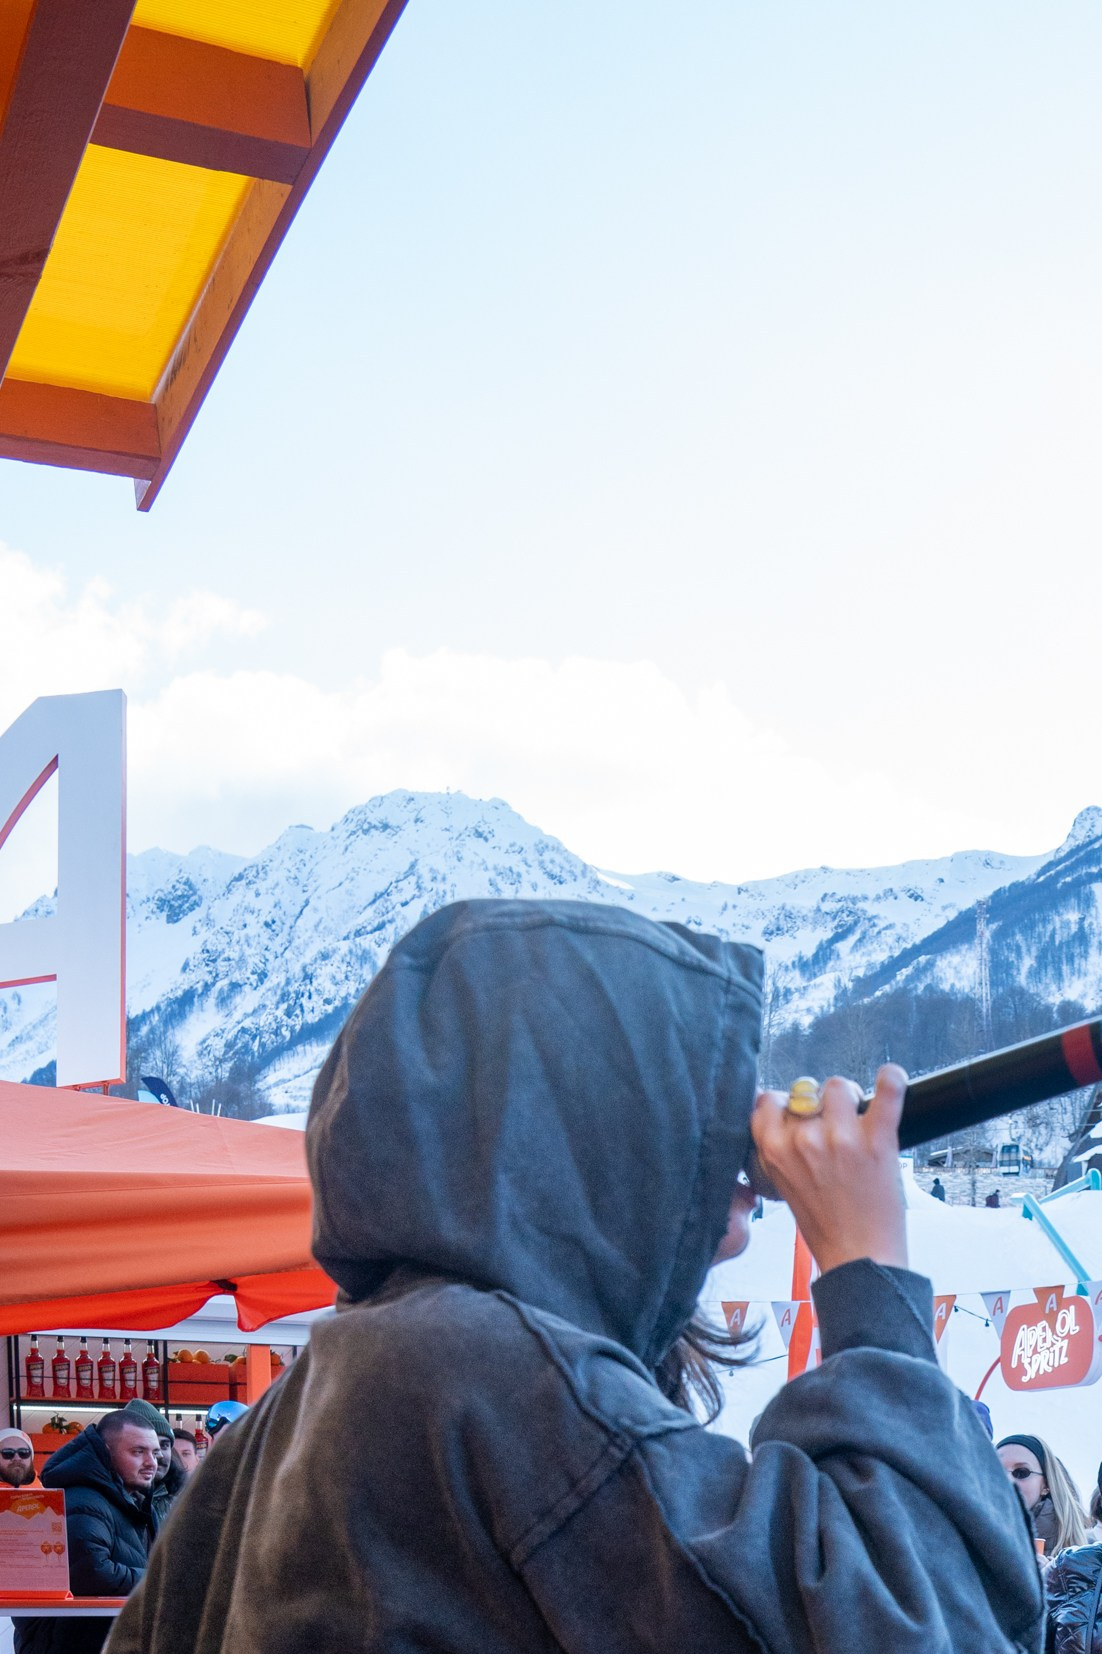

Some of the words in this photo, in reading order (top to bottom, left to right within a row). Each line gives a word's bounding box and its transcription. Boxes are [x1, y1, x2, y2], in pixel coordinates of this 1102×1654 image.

[934, 1302, 946, 1321] A
[992, 1296, 1004, 1317] A
[1045, 1293, 1057, 1314] A
[781, 1308, 791, 1327] A
